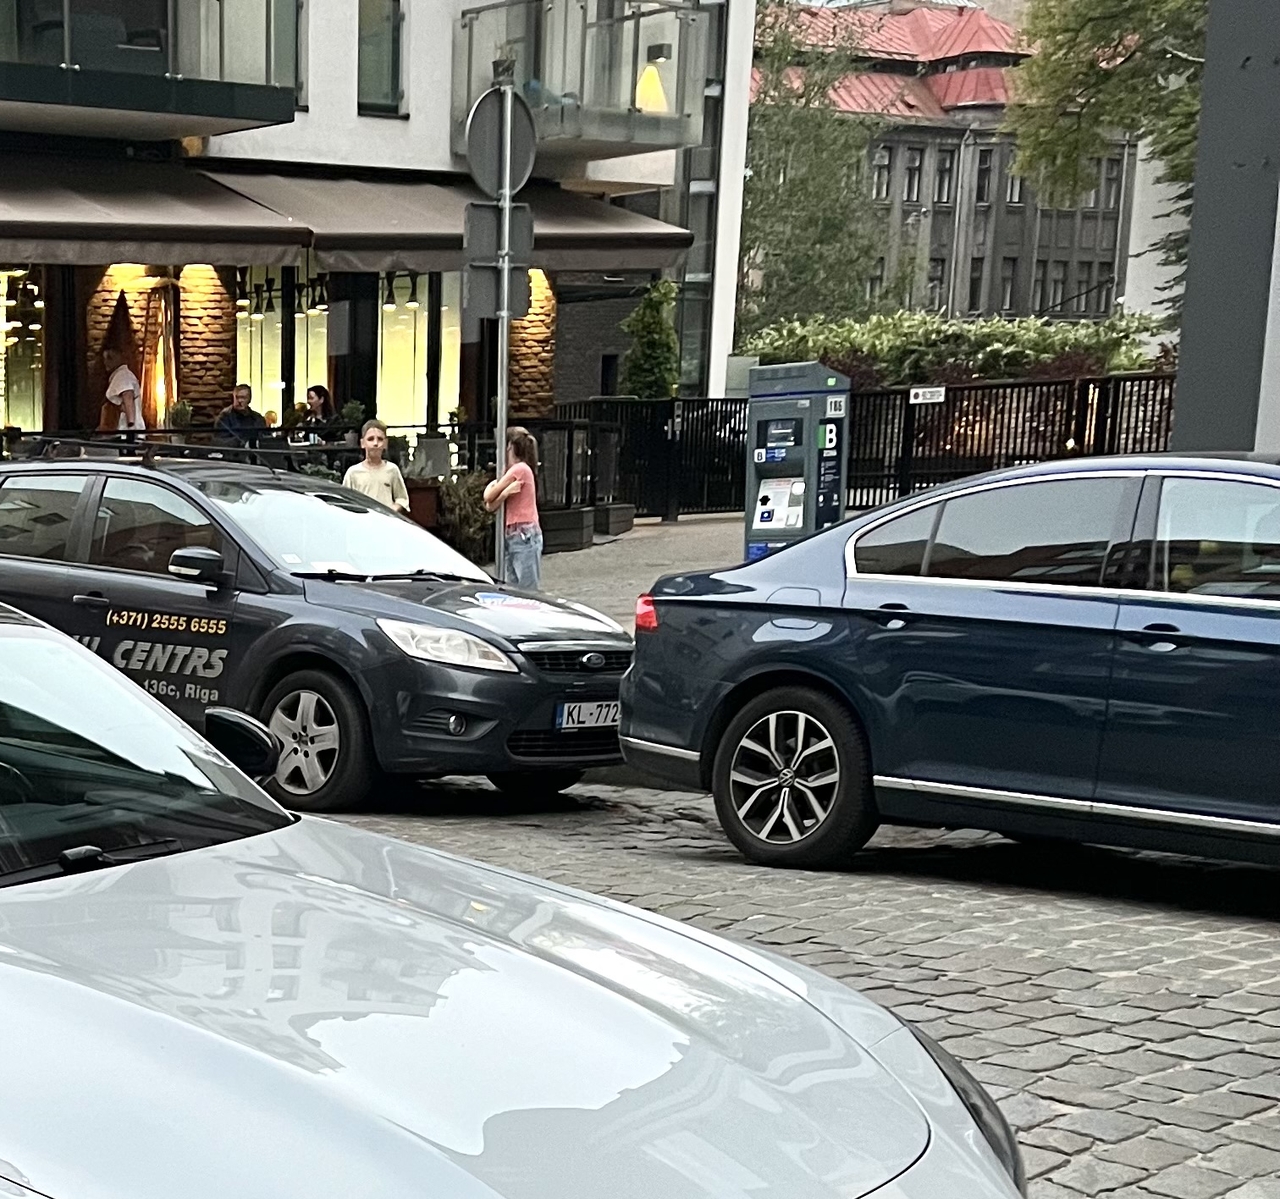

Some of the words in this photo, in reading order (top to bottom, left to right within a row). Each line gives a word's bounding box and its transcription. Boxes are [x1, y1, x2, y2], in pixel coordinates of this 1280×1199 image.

[825, 423, 837, 448] B
[106, 609, 148, 630] (+371)
[151, 614, 187, 631] 2555
[190, 618, 227, 634] 6555
[113, 640, 229, 679] CENTRS
